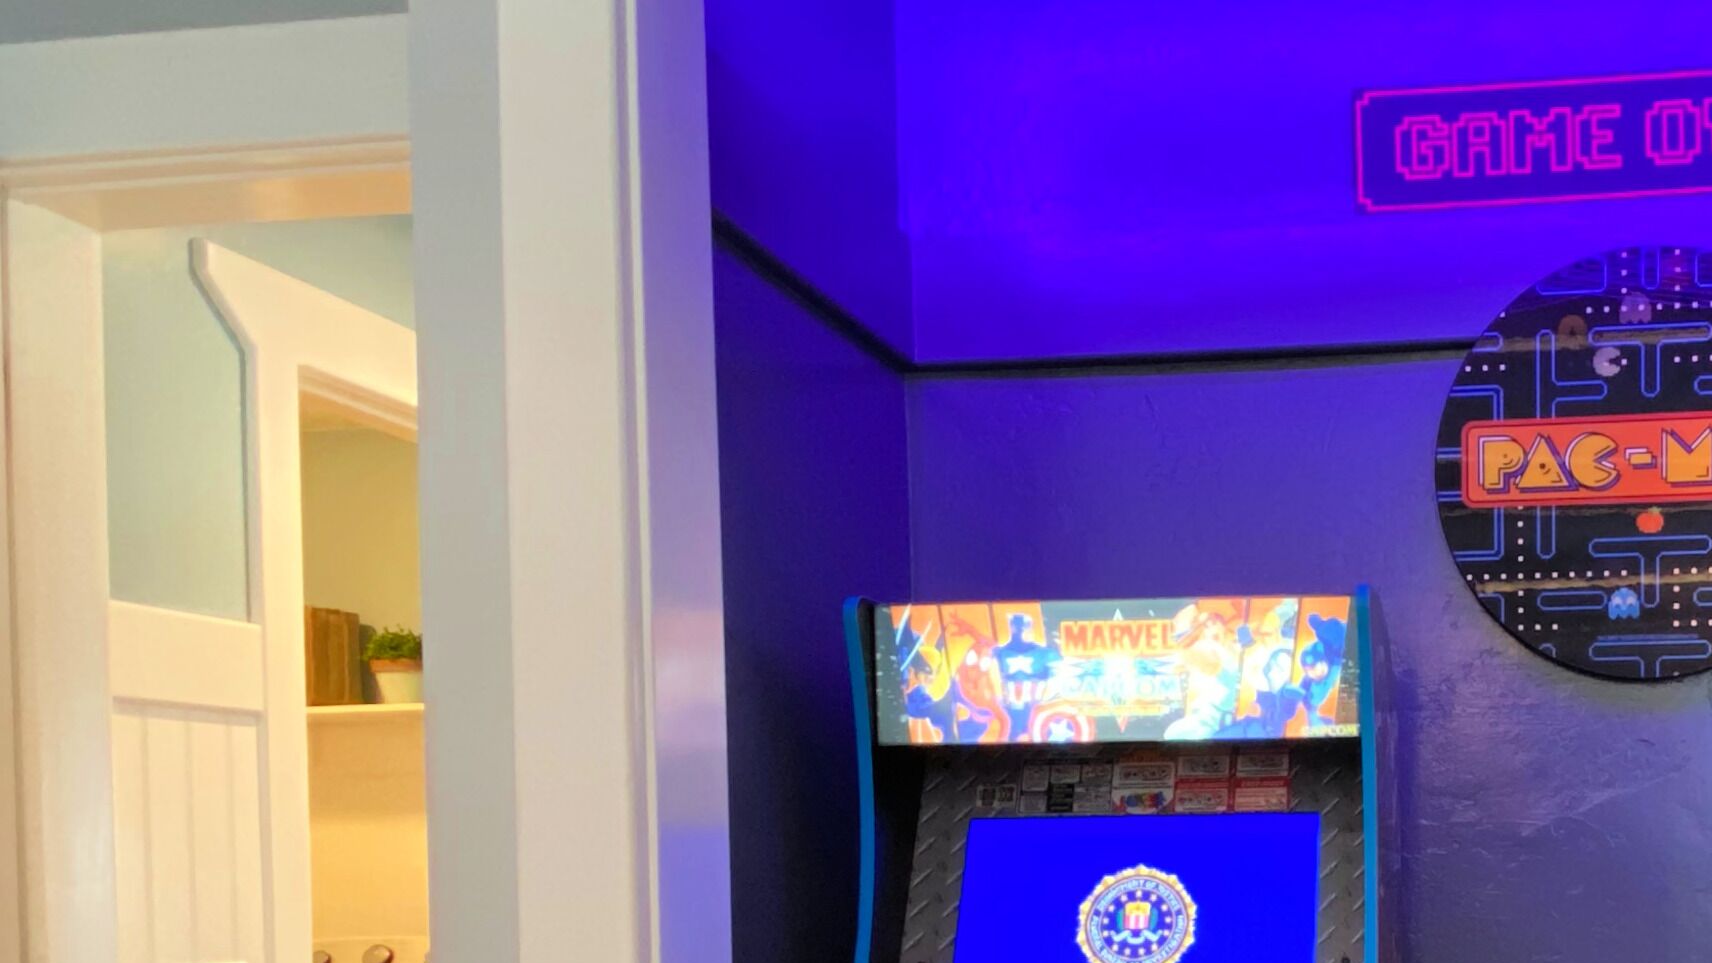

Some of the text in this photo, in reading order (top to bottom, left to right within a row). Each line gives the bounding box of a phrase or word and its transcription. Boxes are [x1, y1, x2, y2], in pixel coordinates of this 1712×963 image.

[1395, 105, 1623, 181] GAME
[1062, 622, 1174, 653] MARVEL
[1060, 675, 1180, 699] CAOM
